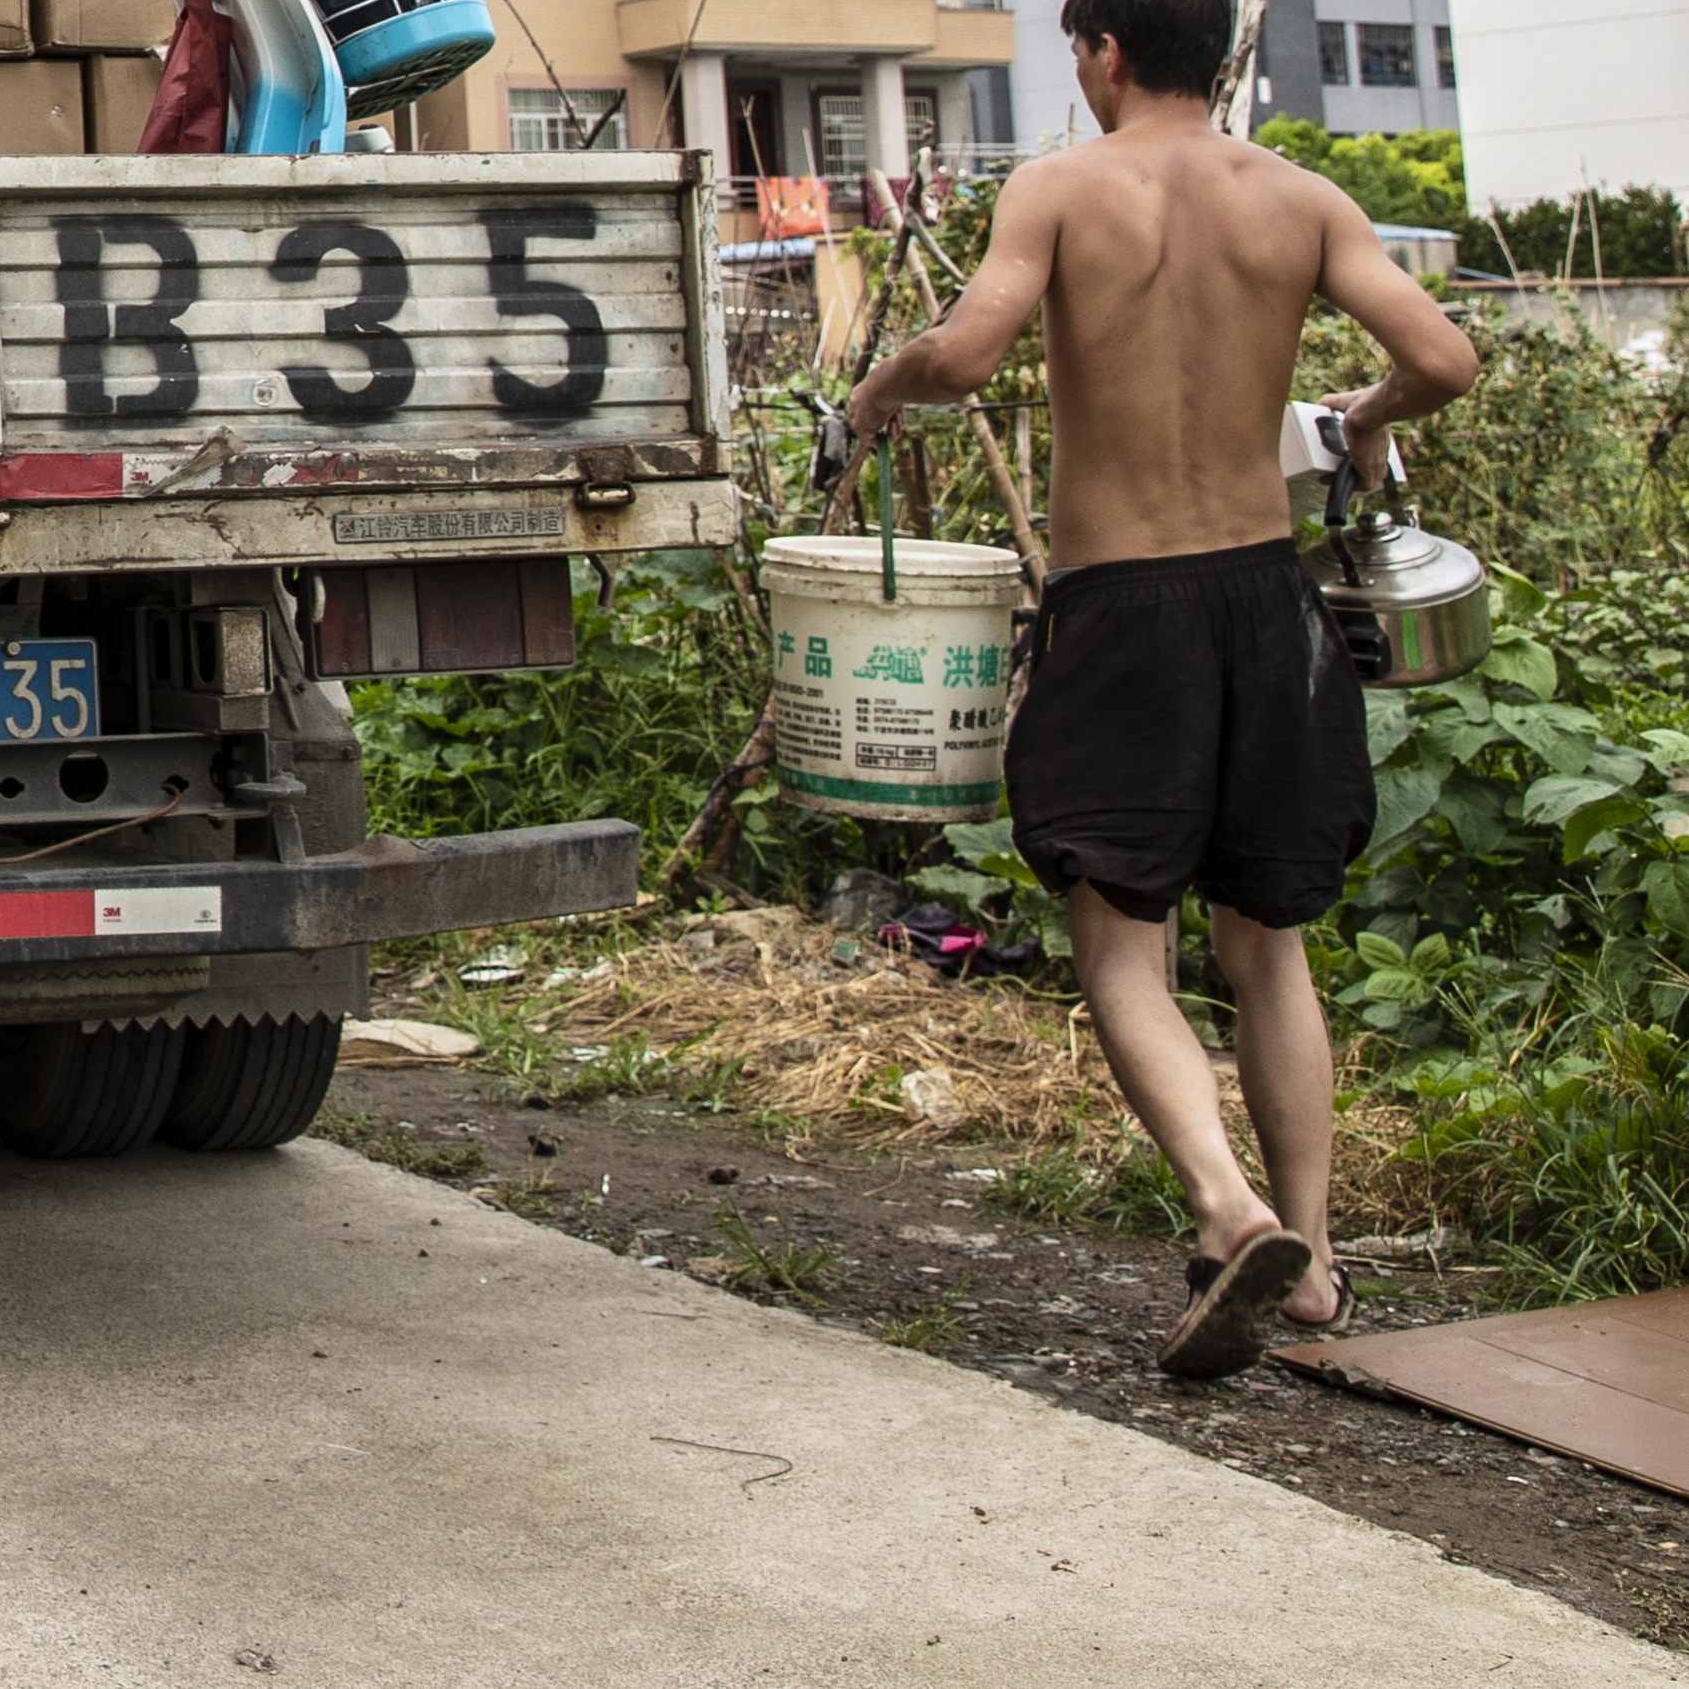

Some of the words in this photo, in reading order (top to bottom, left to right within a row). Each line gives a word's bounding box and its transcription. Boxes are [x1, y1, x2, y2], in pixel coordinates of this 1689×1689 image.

[130, 471, 149, 482] 3M
[359, 508, 560, 540] 江铃汽车股份有限公司制造
[103, 907, 121, 917] 3M
